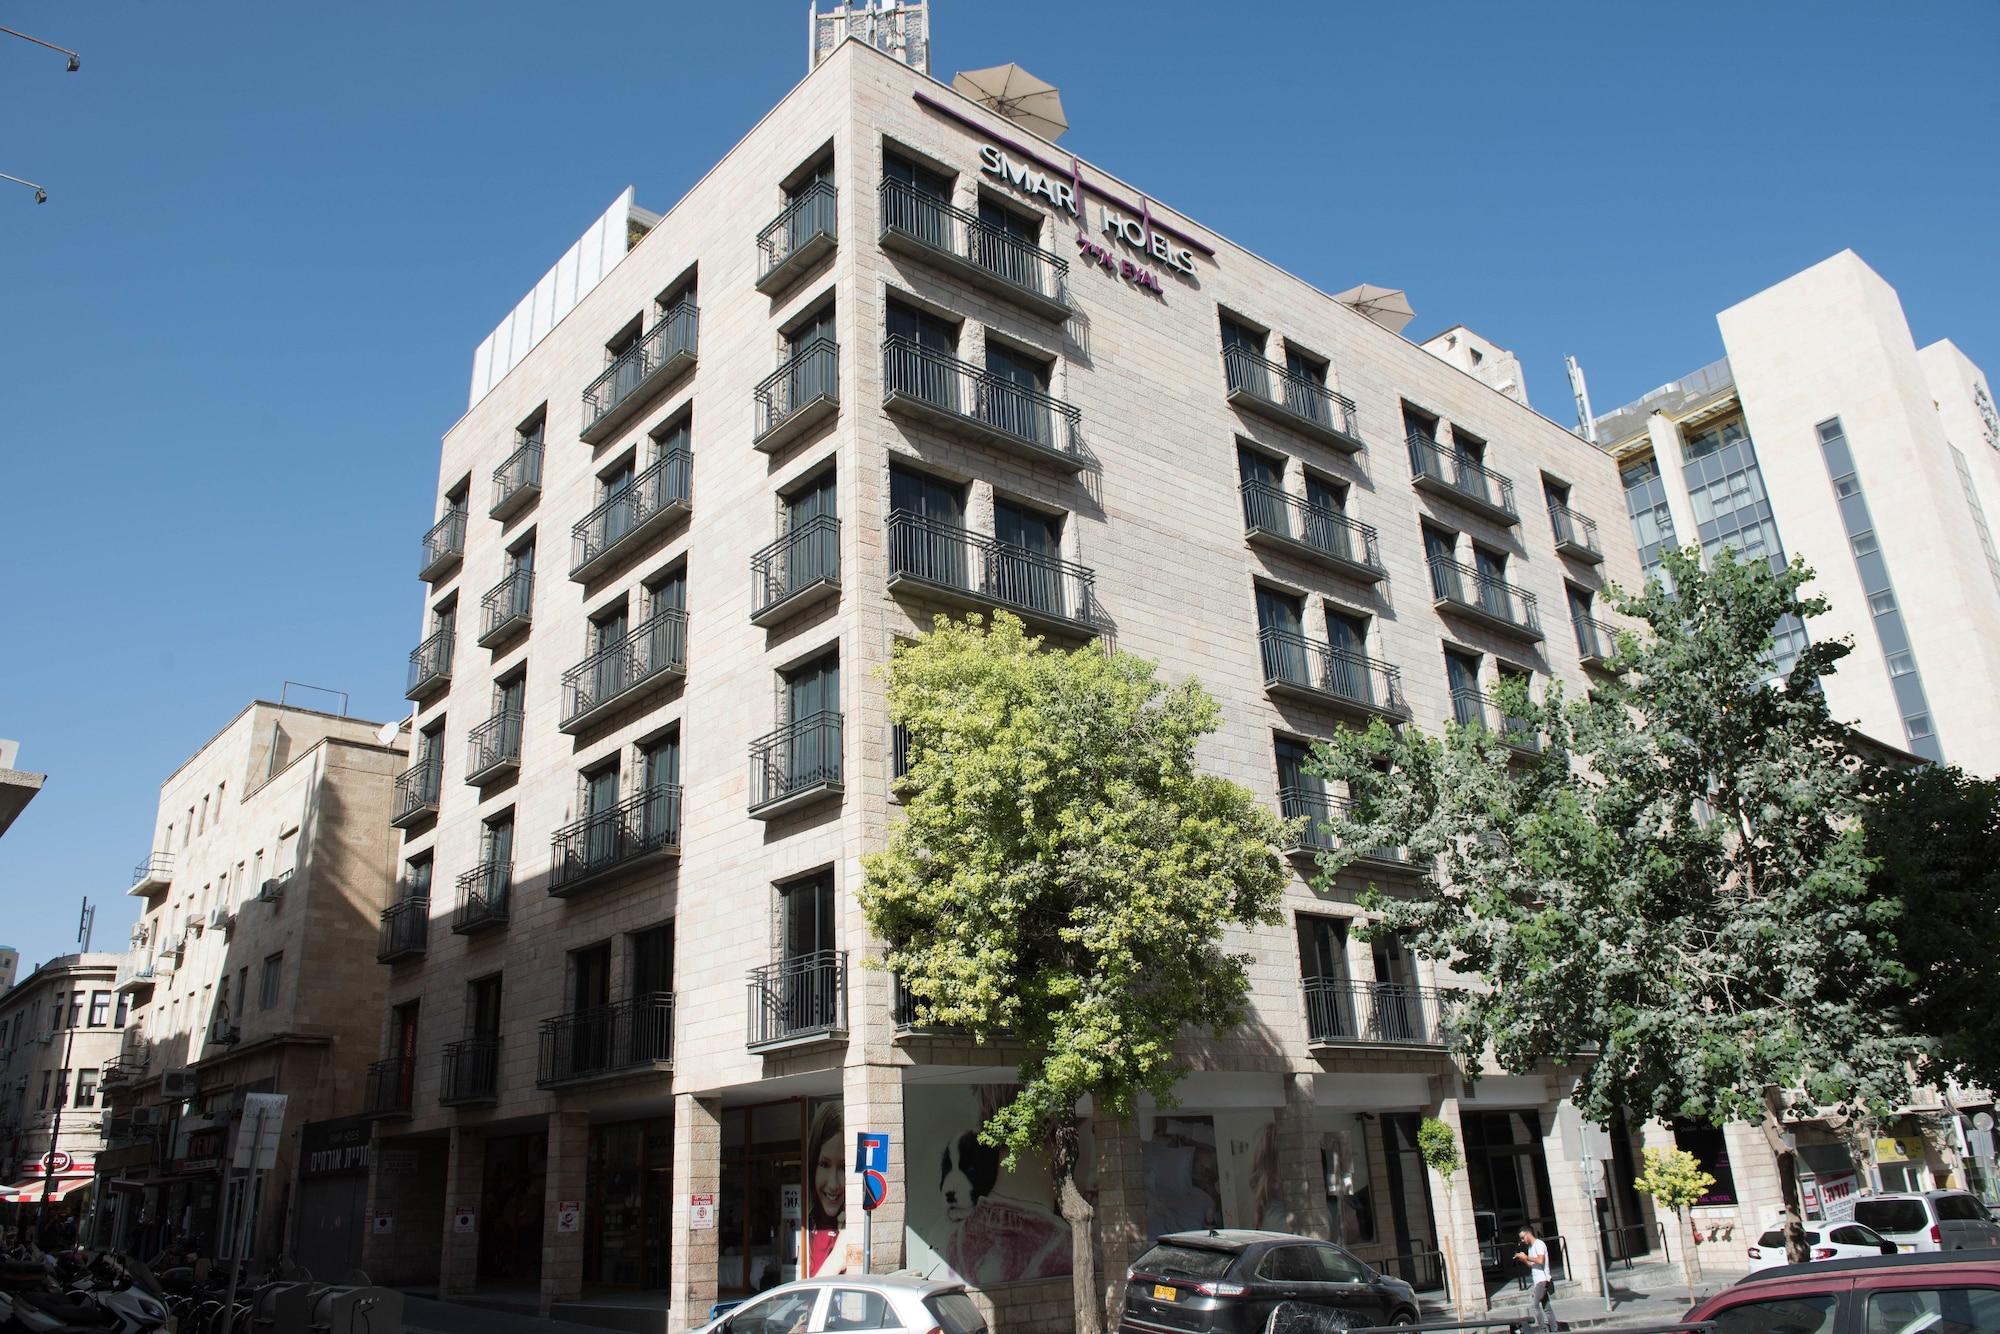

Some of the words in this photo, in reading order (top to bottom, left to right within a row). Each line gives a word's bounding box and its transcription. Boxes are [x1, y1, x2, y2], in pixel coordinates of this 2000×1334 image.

[978, 144, 1084, 217] SMART
[1100, 196, 1197, 274] HOTELS
[1119, 258, 1163, 295] EYAL
